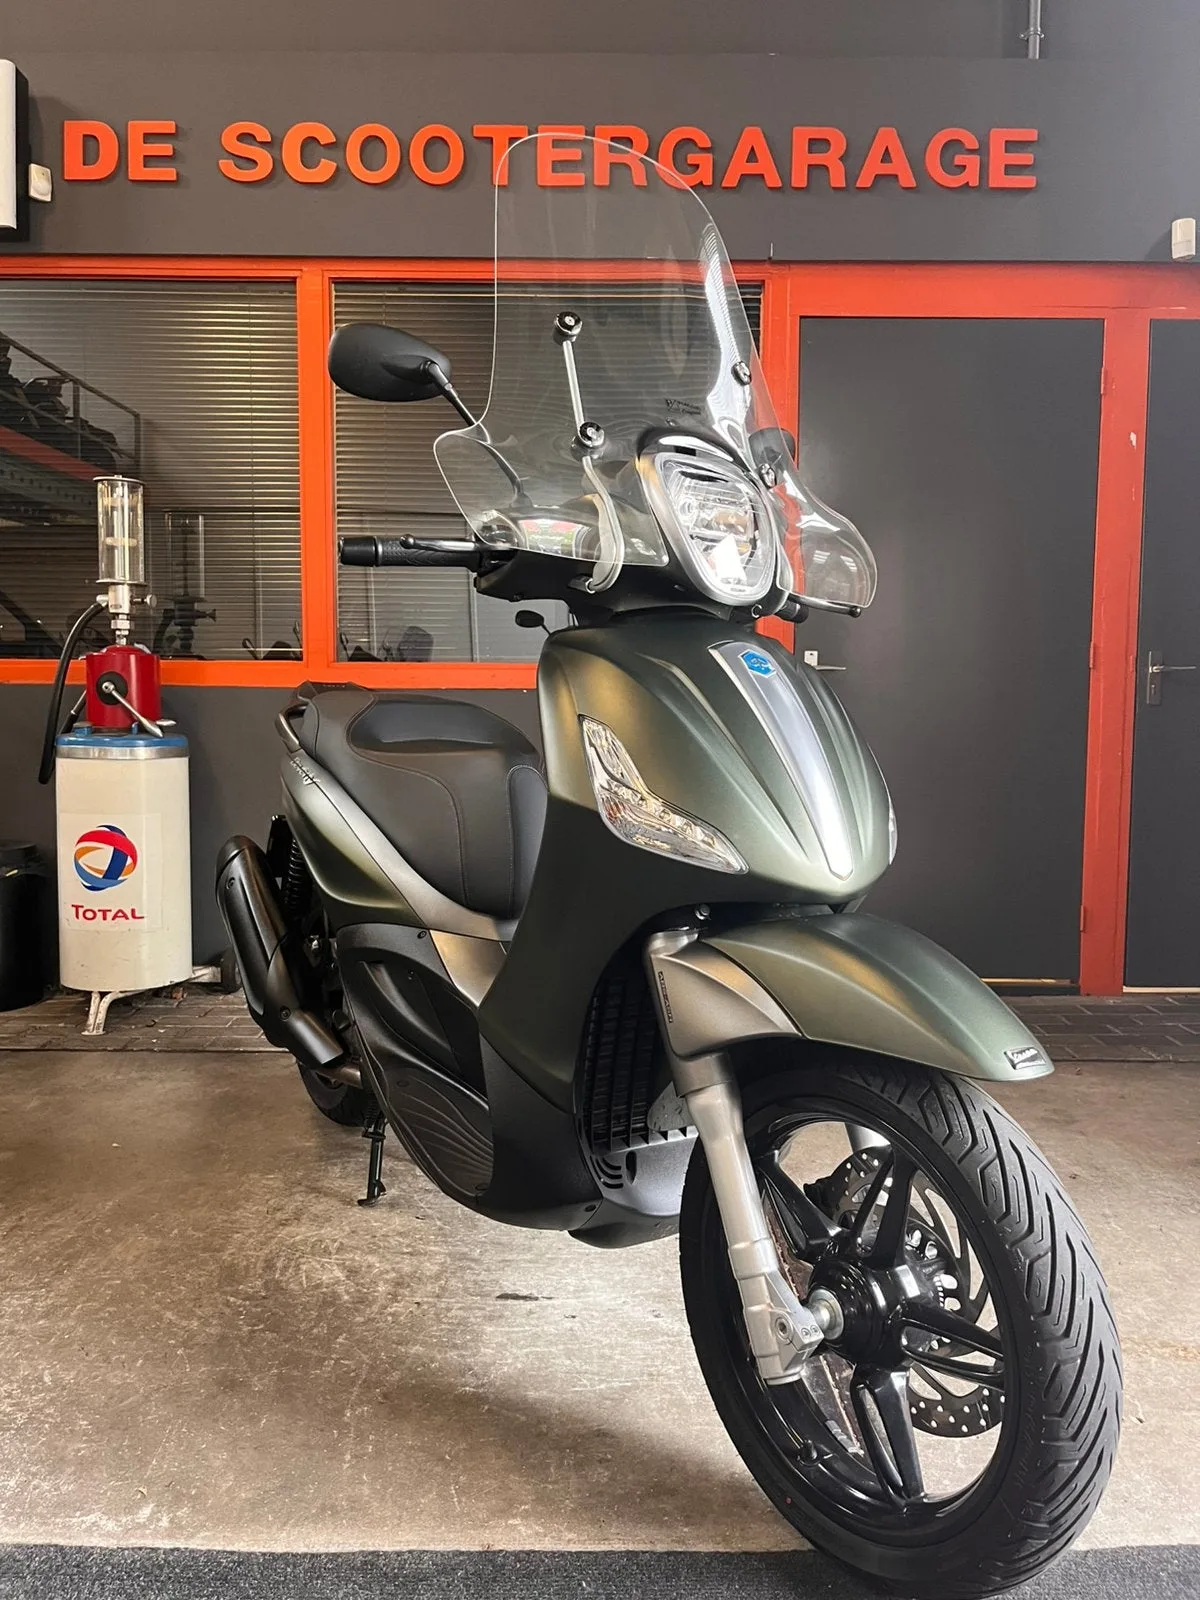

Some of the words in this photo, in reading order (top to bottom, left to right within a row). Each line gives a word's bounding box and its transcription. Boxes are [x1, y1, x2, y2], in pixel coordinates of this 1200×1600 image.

[63, 120, 177, 183] DE
[218, 122, 1036, 188] SCOOTERGARAGE
[71, 904, 144, 921] TOTAL
